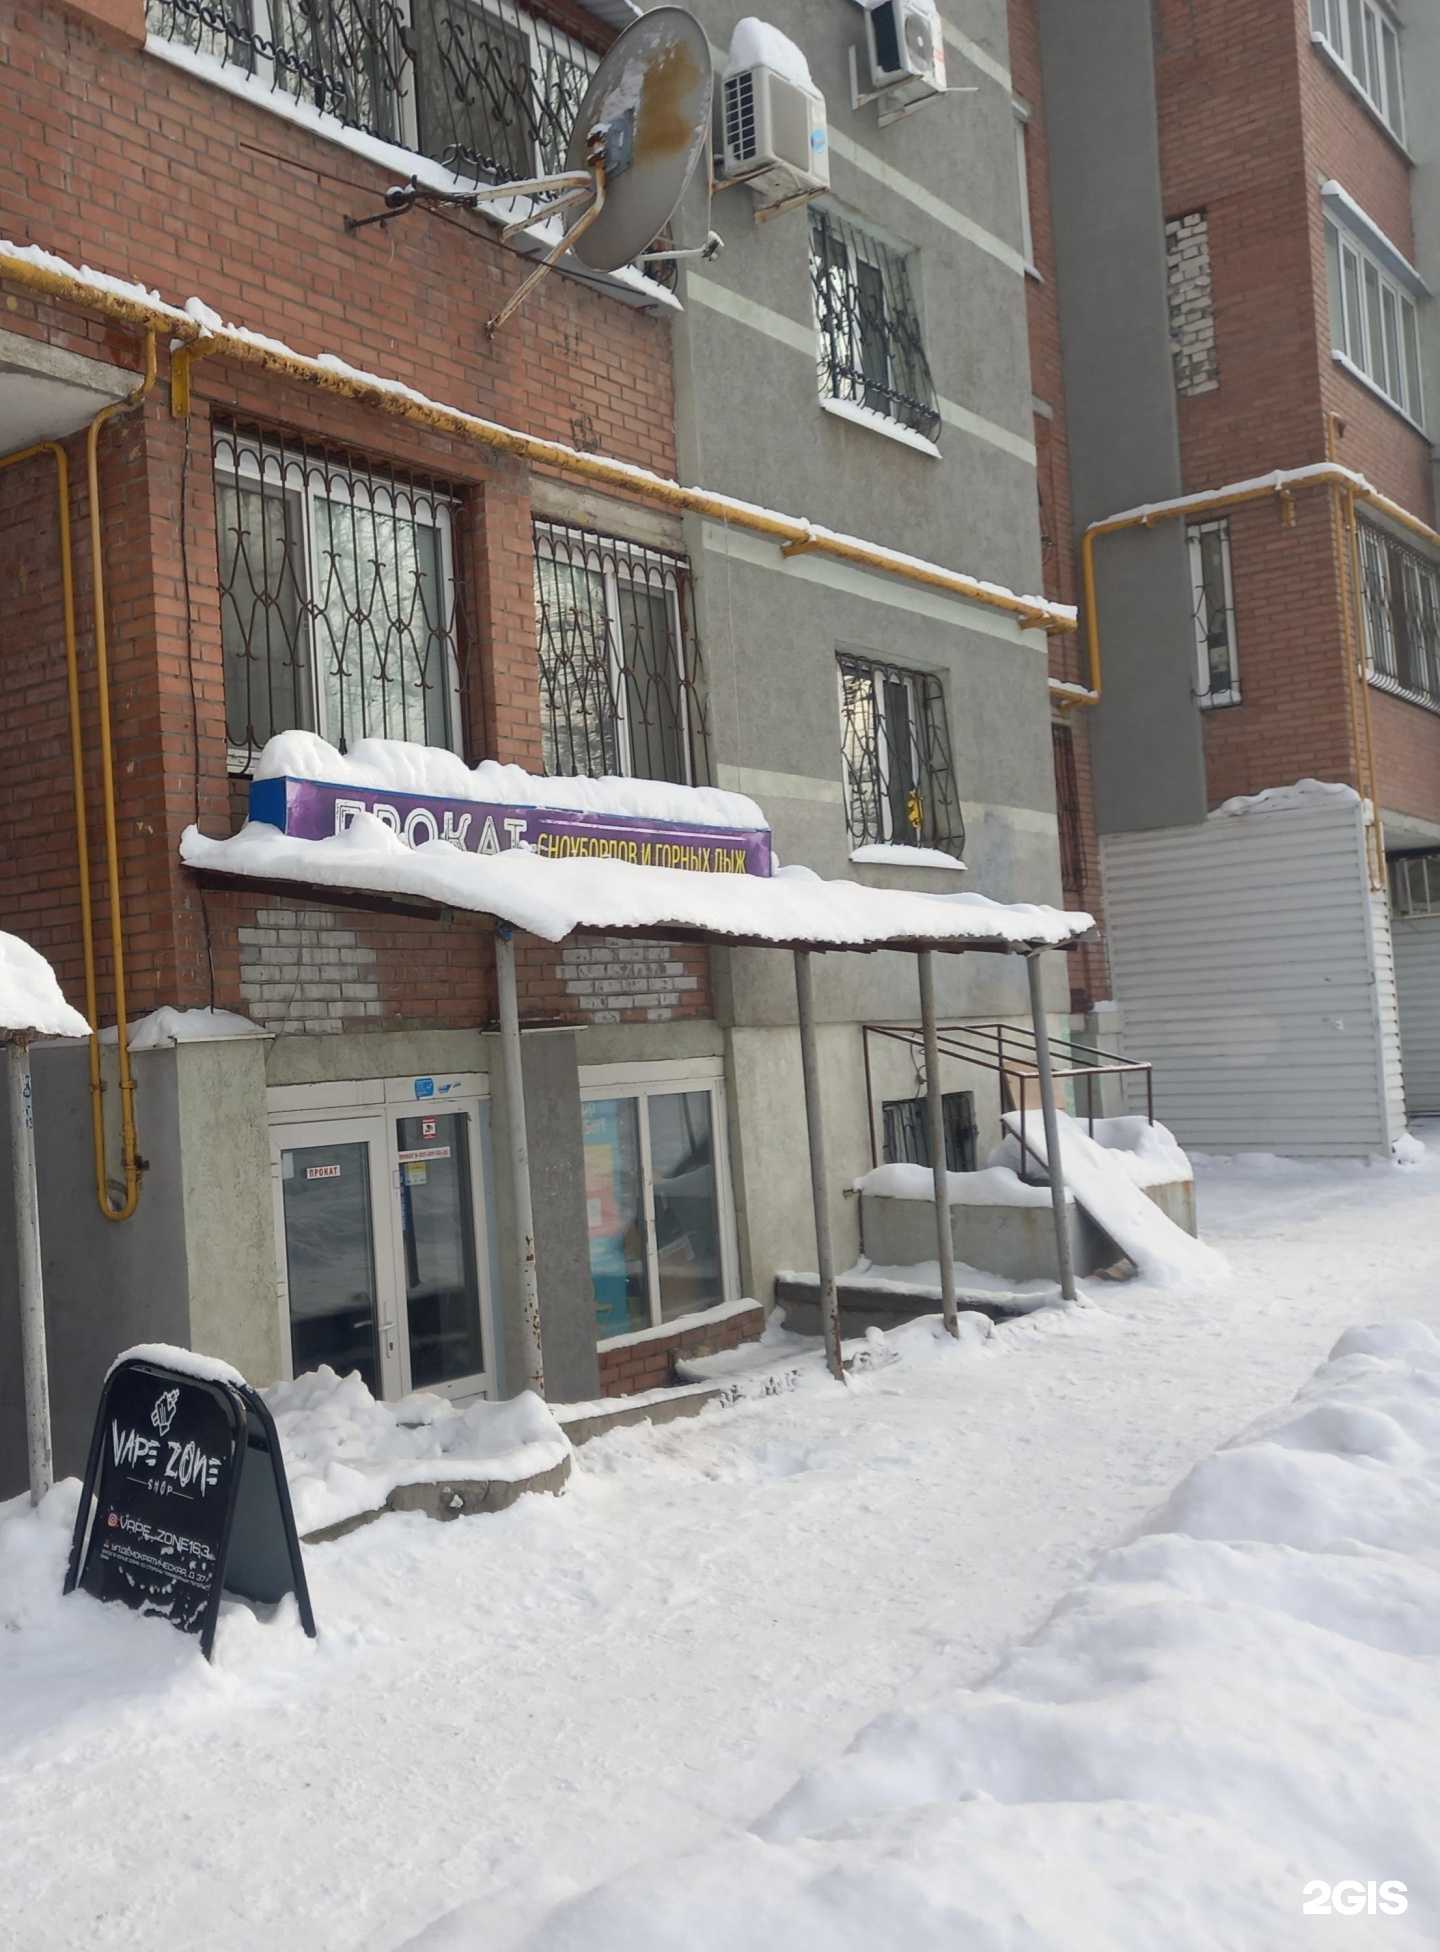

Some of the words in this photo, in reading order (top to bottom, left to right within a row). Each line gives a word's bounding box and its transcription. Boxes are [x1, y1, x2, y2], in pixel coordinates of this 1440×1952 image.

[641, 842, 651, 865] И
[655, 844, 710, 873] ГОРНЫХ
[713, 848, 747, 875] ЛЫЖ
[310, 1167, 337, 1177] ПРОКАТ
[112, 1418, 160, 1469] VAPE
[164, 1440, 222, 1498] ZONE
[147, 1478, 173, 1496] SHOP
